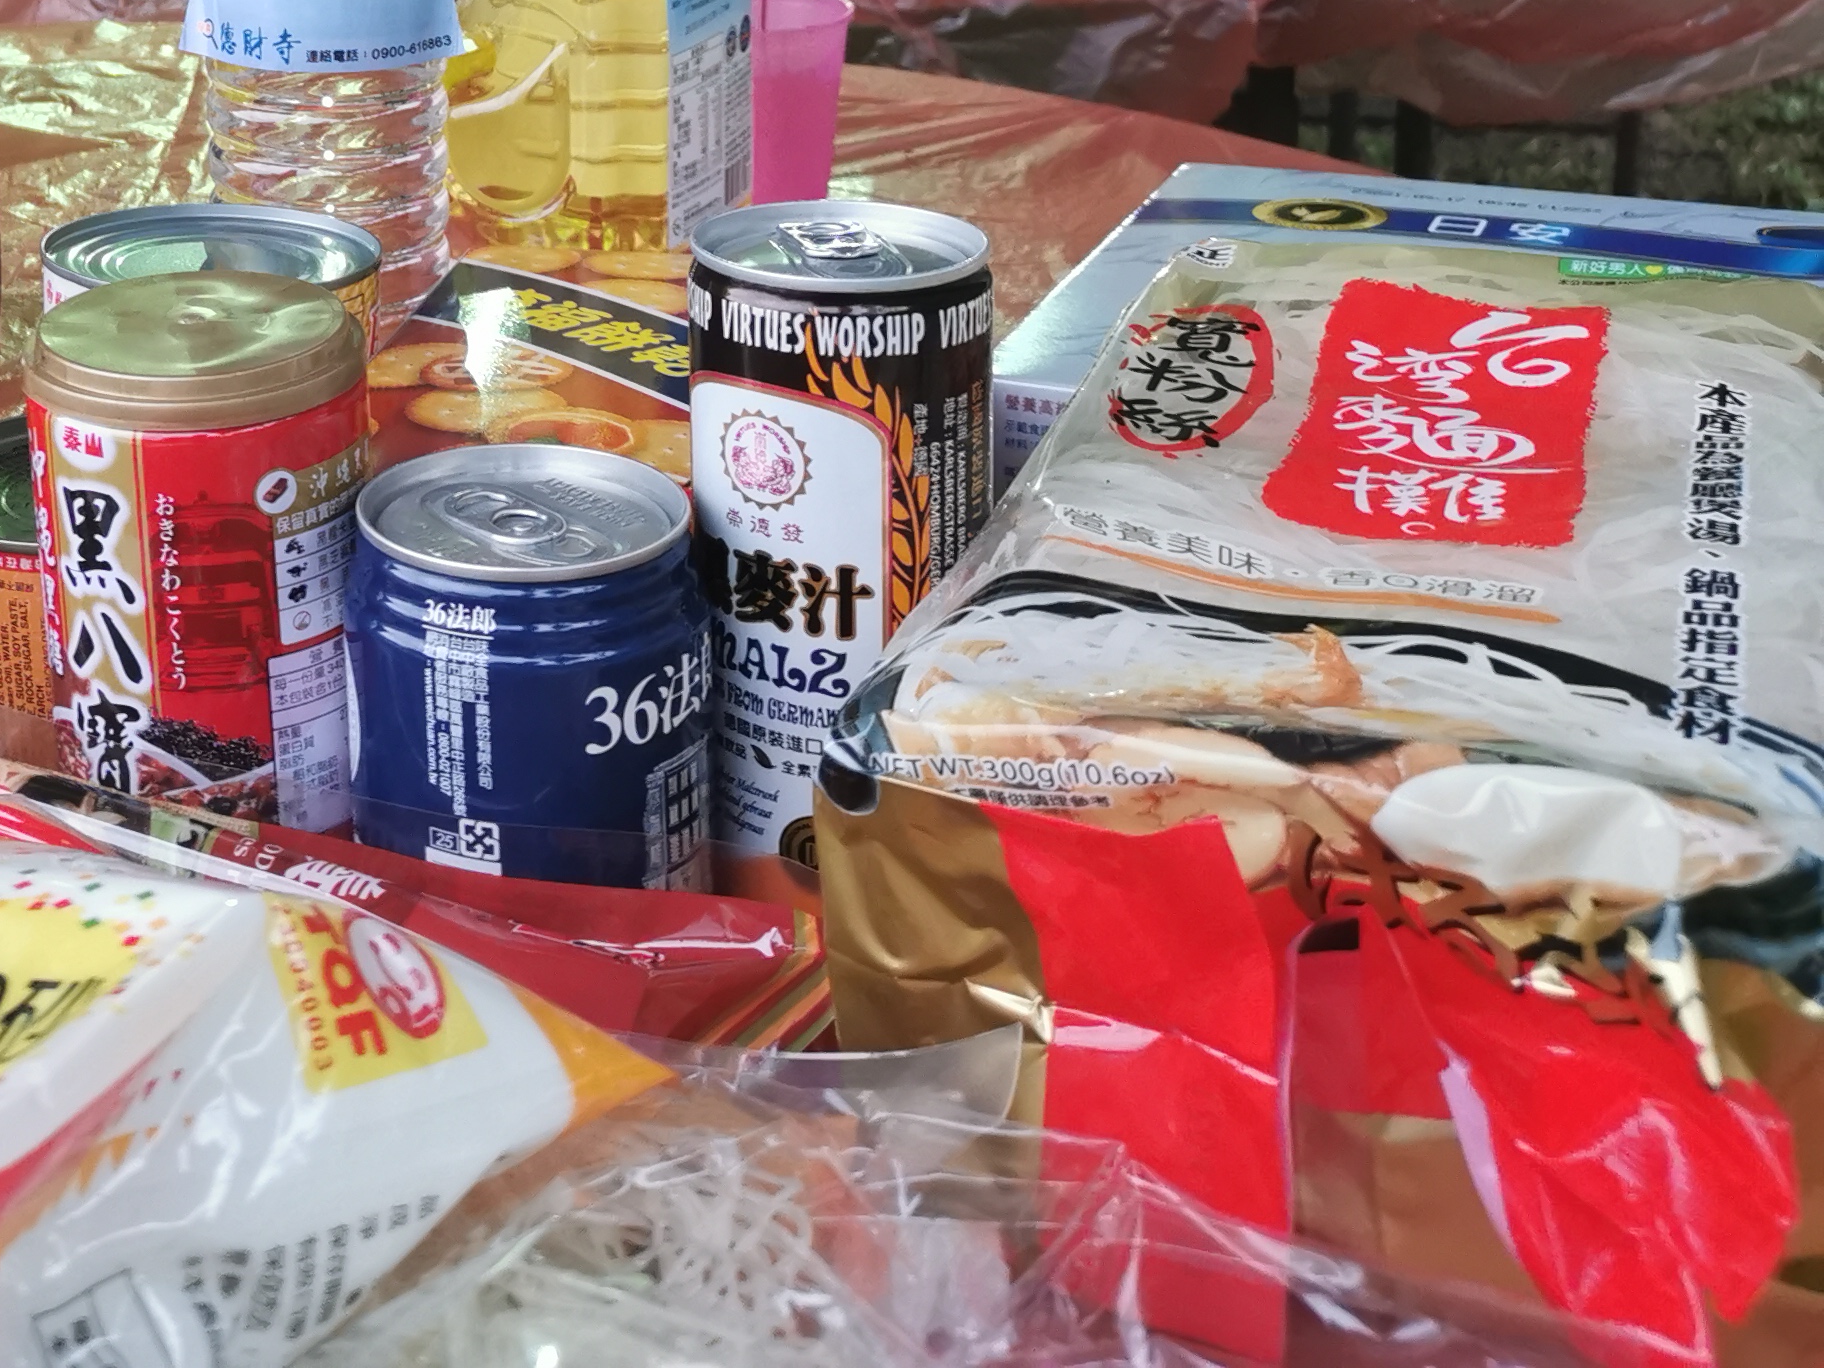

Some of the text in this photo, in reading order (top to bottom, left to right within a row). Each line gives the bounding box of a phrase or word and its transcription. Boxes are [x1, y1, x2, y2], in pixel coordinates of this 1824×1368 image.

[1427, 214, 1572, 245] 日安
[1569, 260, 1647, 277] 新好男人
[720, 297, 807, 356] VIRTUES
[815, 311, 927, 359] WORSHIP
[1110, 315, 1262, 449] 寬粉絲
[154, 492, 188, 692] おきなわこくとう
[421, 597, 498, 634] 36法郎
[24, 674, 35, 704] ROCK
[434, 832, 456, 849] 25
